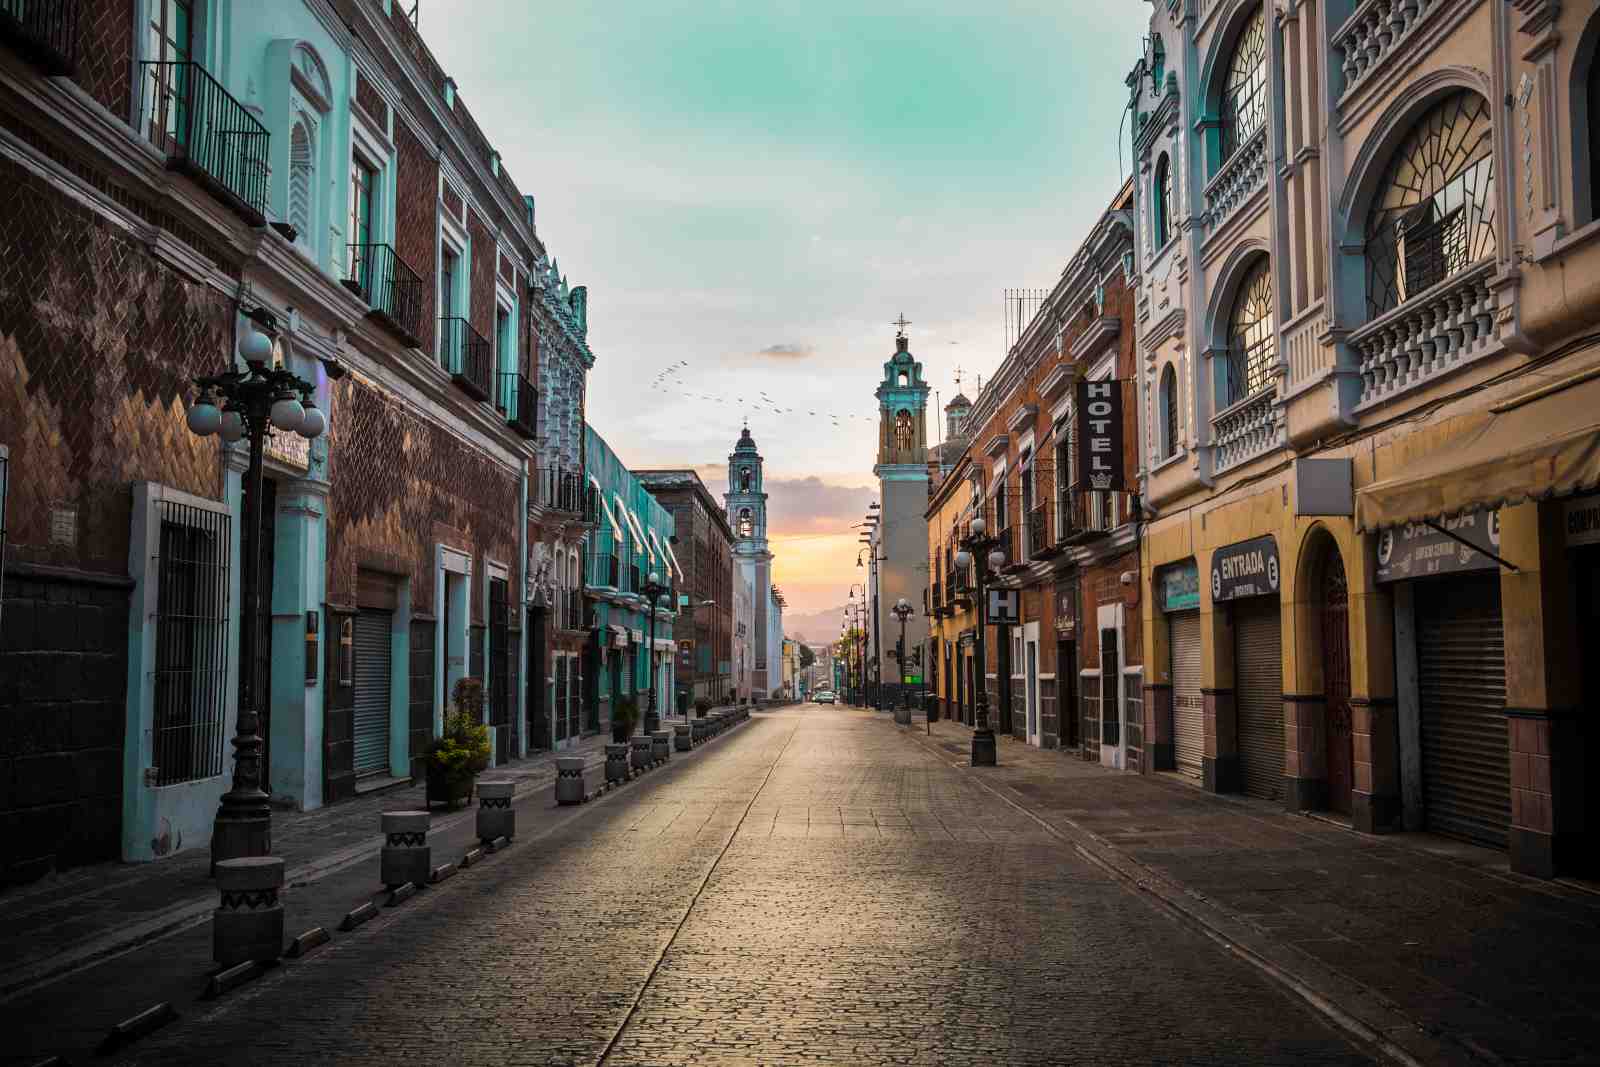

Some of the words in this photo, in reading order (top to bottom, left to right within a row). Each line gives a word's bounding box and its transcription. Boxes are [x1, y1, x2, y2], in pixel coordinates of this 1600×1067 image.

[1087, 383, 1112, 470] HOTEL
[1221, 549, 1265, 579] ENTRADA
[989, 590, 1017, 618] H
